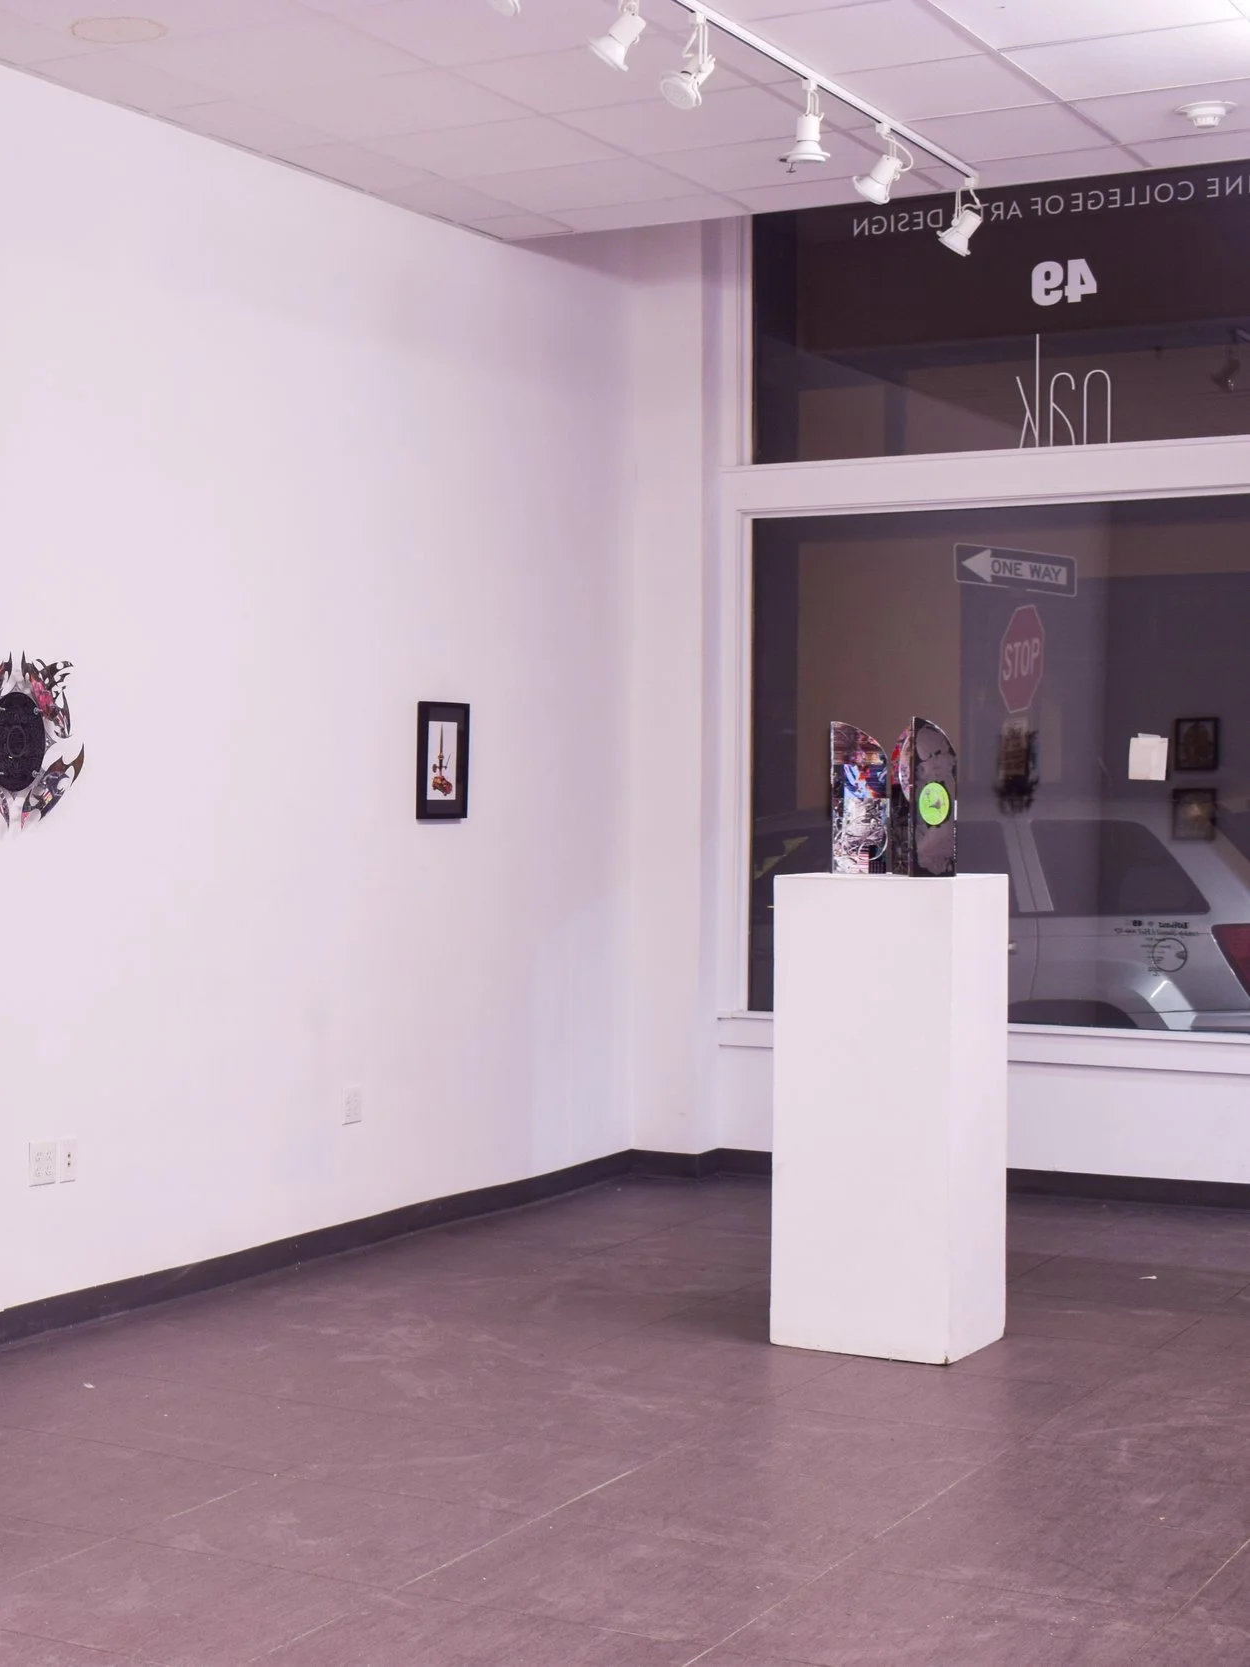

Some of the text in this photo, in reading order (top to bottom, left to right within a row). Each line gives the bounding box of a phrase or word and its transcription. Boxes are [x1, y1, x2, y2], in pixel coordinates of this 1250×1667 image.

[991, 559, 1062, 582] ONE WAY
[1002, 637, 1040, 681] STOP
